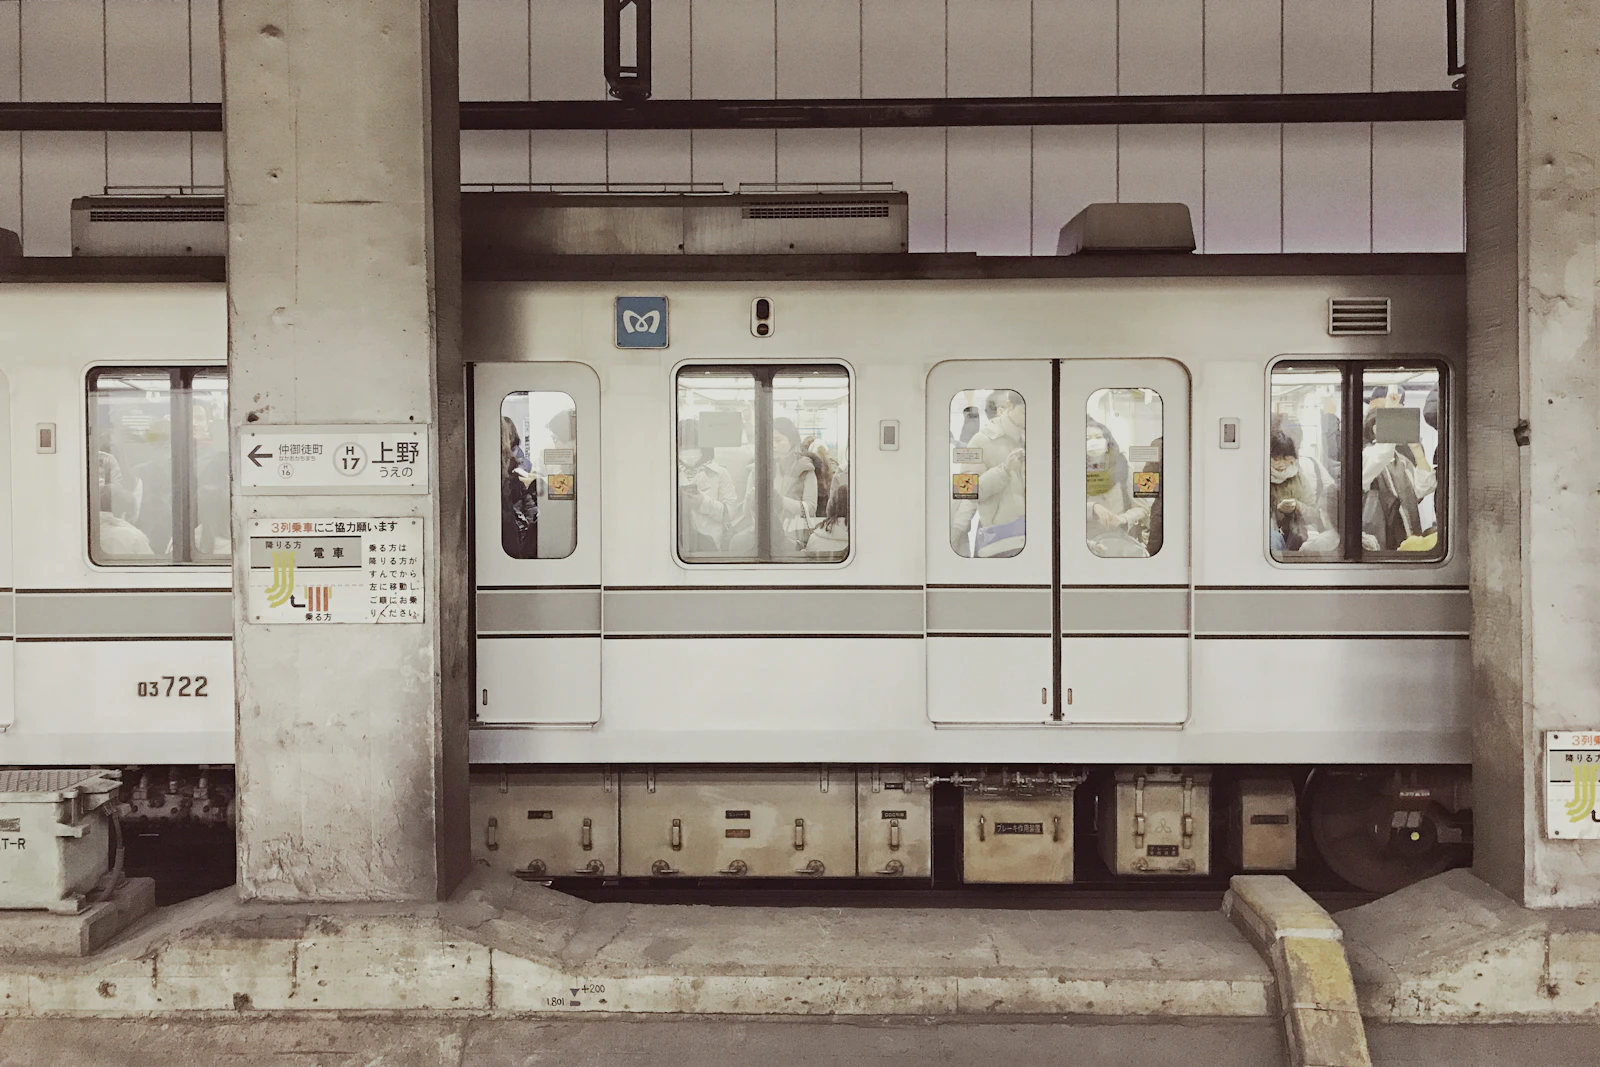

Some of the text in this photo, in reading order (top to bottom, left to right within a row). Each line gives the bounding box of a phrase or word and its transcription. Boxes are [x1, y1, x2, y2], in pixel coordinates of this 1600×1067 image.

[278, 444, 323, 455] 仲御徒町
[345, 446, 354, 456] H
[371, 441, 419, 465] 上野
[341, 457, 360, 470] 17
[379, 467, 413, 478] うえの
[271, 521, 398, 534] 3列乗車にご協力願います
[265, 541, 302, 549] 降りる方
[369, 544, 407, 552] 乗る方は
[313, 547, 345, 559] 電車
[369, 557, 417, 565] 降りる方が
[369, 570, 417, 578] すんでから
[305, 613, 332, 621] 乗る方
[137, 676, 208, 697] 03722
[0, 837, 26, 850] T-R
[581, 984, 606, 994] +200
